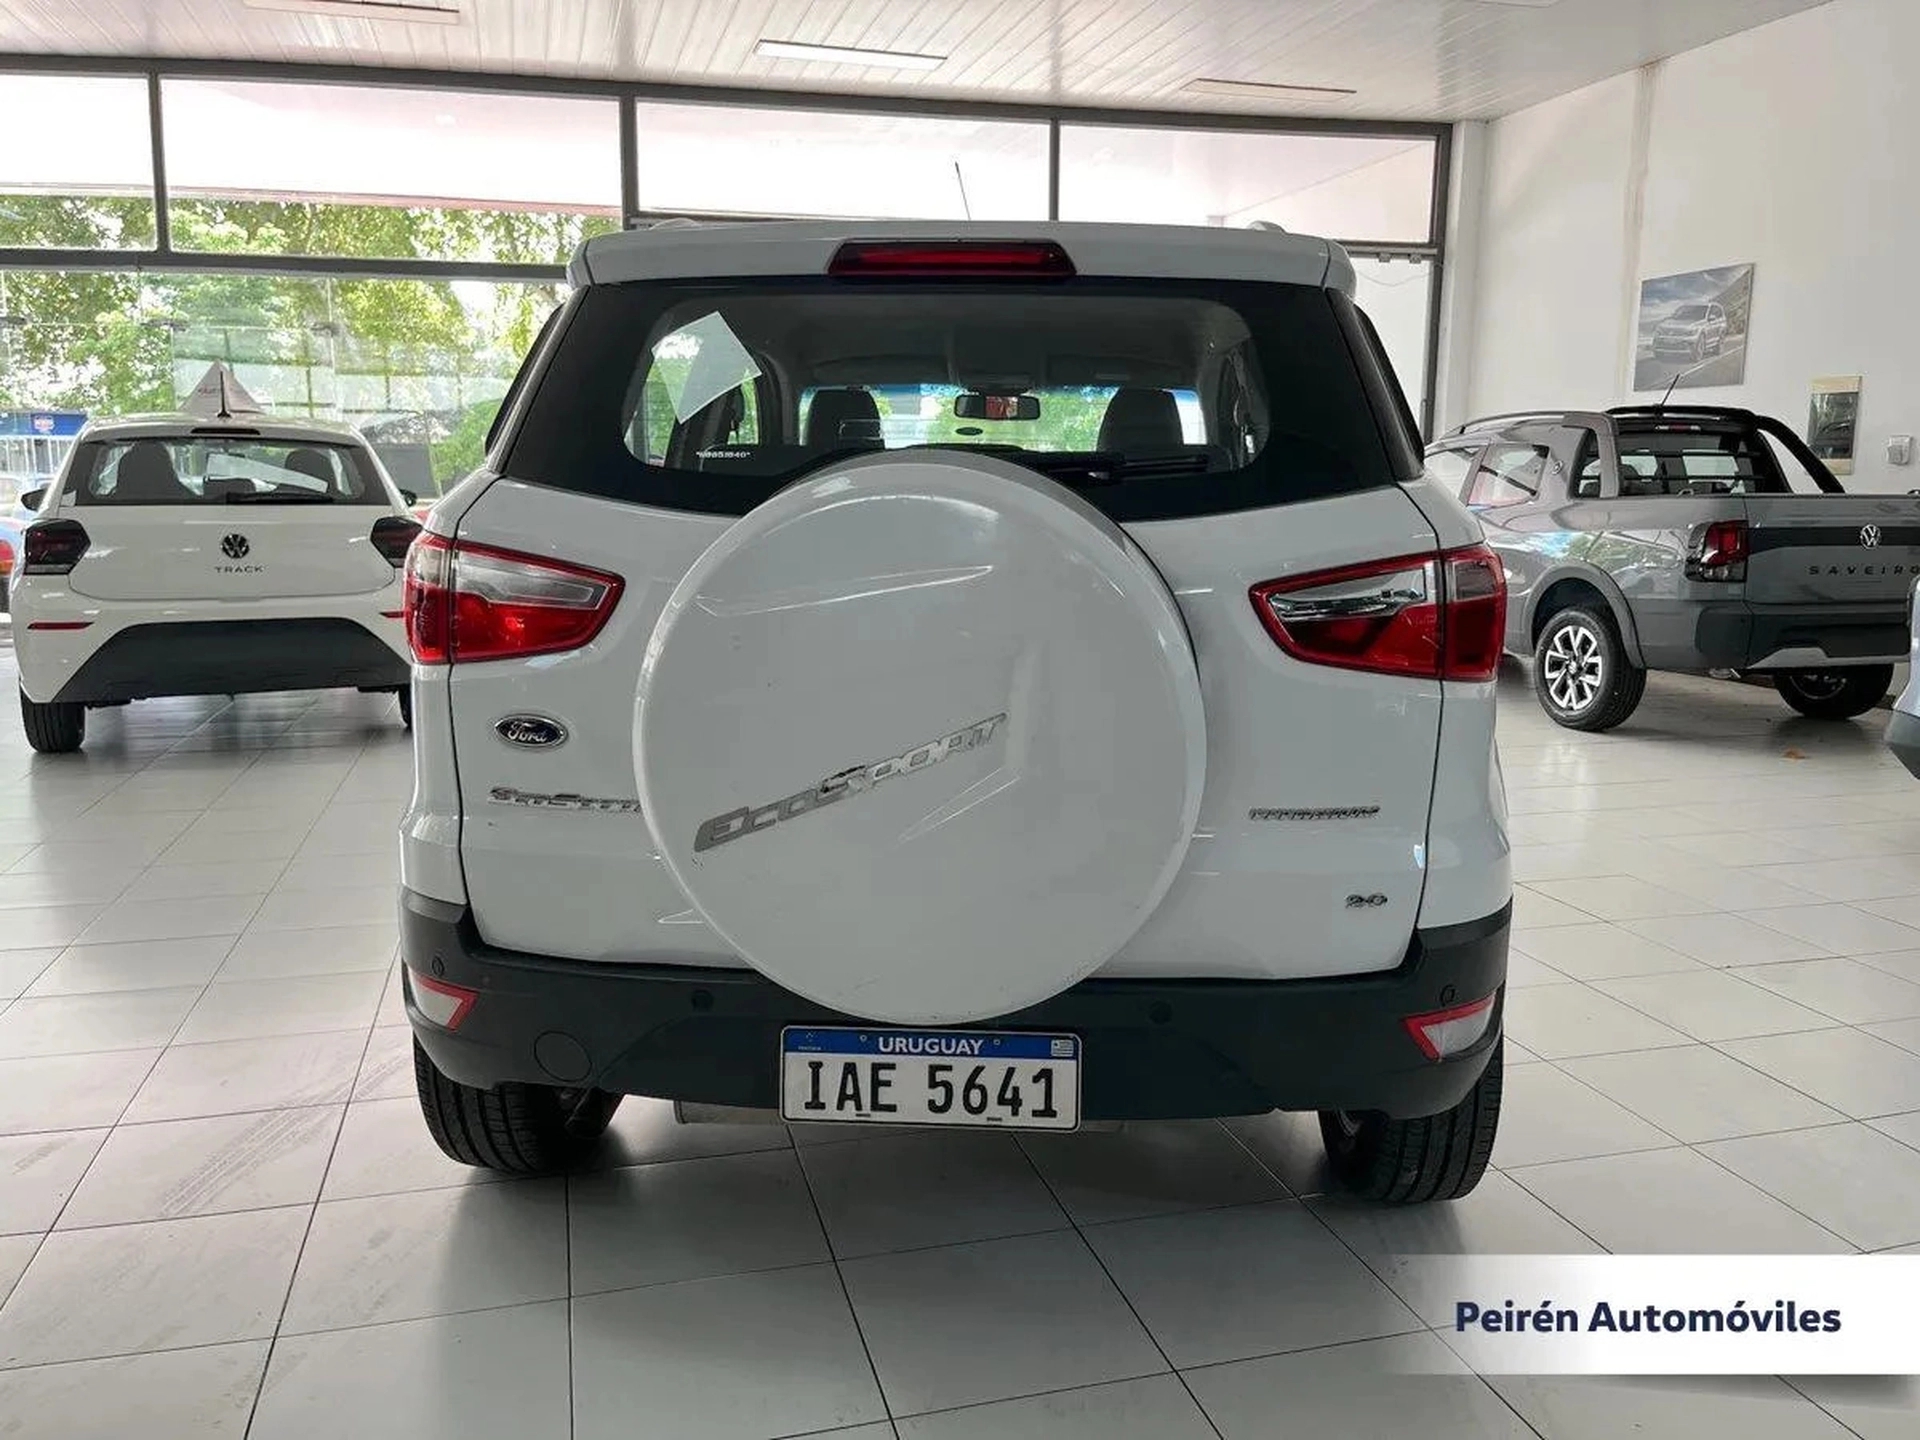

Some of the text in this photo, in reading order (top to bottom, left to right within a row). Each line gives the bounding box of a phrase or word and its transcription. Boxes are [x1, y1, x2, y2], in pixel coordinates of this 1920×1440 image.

[214, 565, 265, 574] TRACK
[1808, 565, 1920, 576] SAVEIRO
[878, 1036, 984, 1055] URUGUAY
[804, 1061, 1057, 1118] IAE 5641
